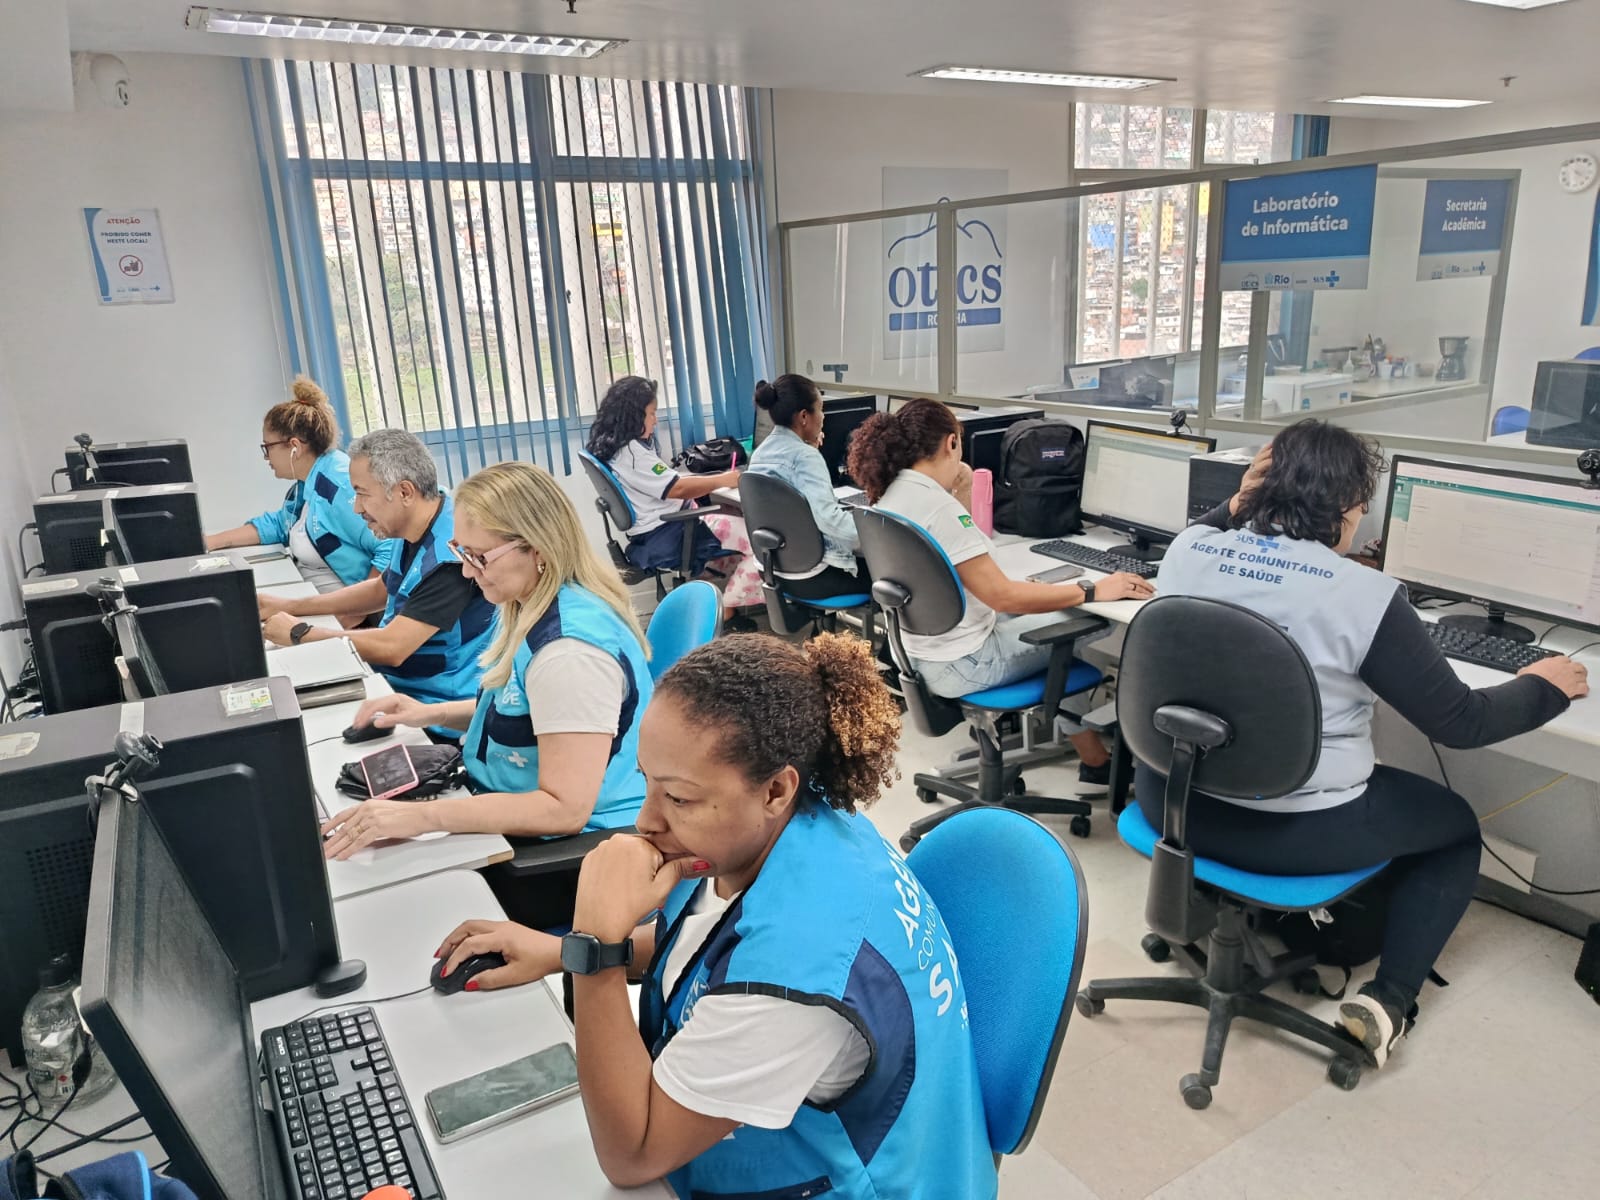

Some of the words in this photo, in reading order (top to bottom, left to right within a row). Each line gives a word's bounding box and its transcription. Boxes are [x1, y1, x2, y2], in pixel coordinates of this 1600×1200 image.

[1252, 190, 1339, 213] Laboratório
[1446, 196, 1487, 211] Secretaria
[106, 216, 141, 225] ATENÇÃO
[1241, 221, 1259, 237] de
[1262, 214, 1348, 236] Informática
[888, 262, 1002, 308] otcs
[1274, 274, 1290, 285] Rio
[1235, 533, 1255, 545] SUS
[1218, 563, 1236, 575] DE
[1238, 567, 1284, 585] SAÚDE
[1238, 552, 1334, 580] COMUNITÁRIO
